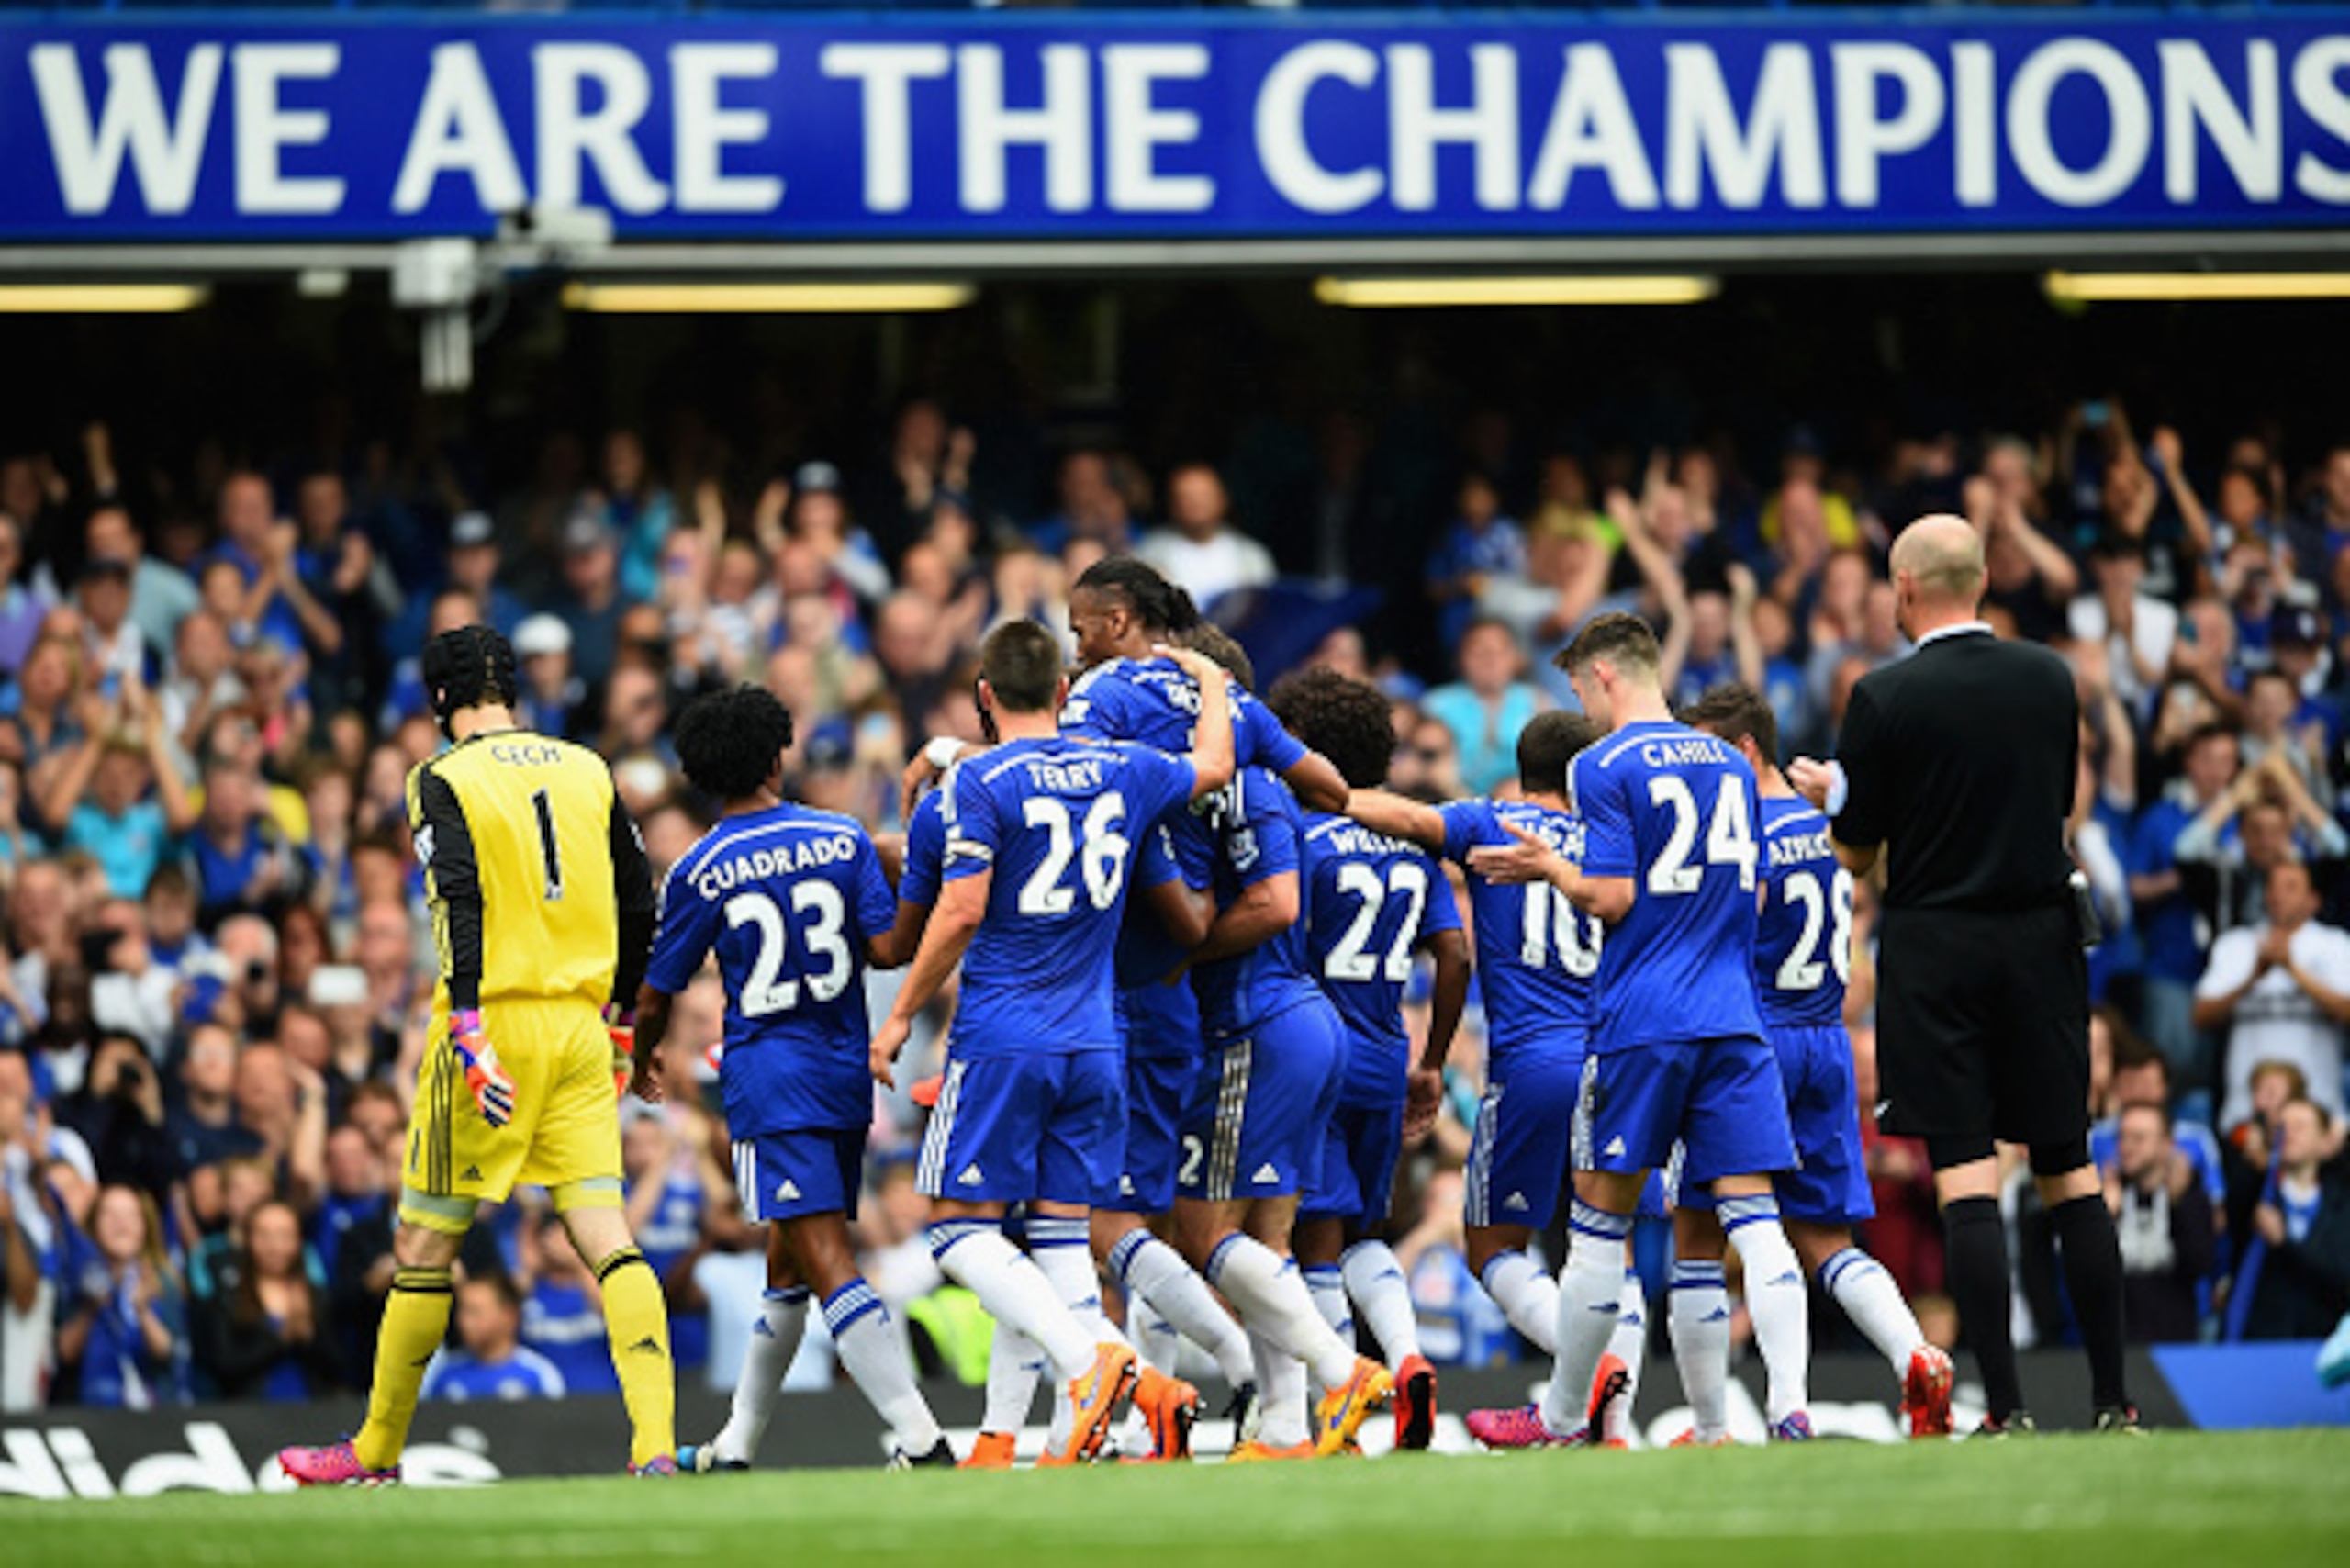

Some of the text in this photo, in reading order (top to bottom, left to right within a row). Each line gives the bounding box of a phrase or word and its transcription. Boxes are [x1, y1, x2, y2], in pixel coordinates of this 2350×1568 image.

[28, 35, 2350, 215] WE ARE THE CHAMPIONS
[491, 745, 562, 766] CECH
[1026, 760, 1102, 790] TERRY
[1641, 740, 1729, 767] CAHILL
[530, 787, 564, 901] 1
[699, 834, 857, 902] CUADRADO
[1017, 790, 1131, 915] 26
[1646, 772, 1760, 896] 24
[723, 878, 854, 1018] 23
[1324, 861, 1428, 983] 22
[1520, 879, 1603, 987] 10
